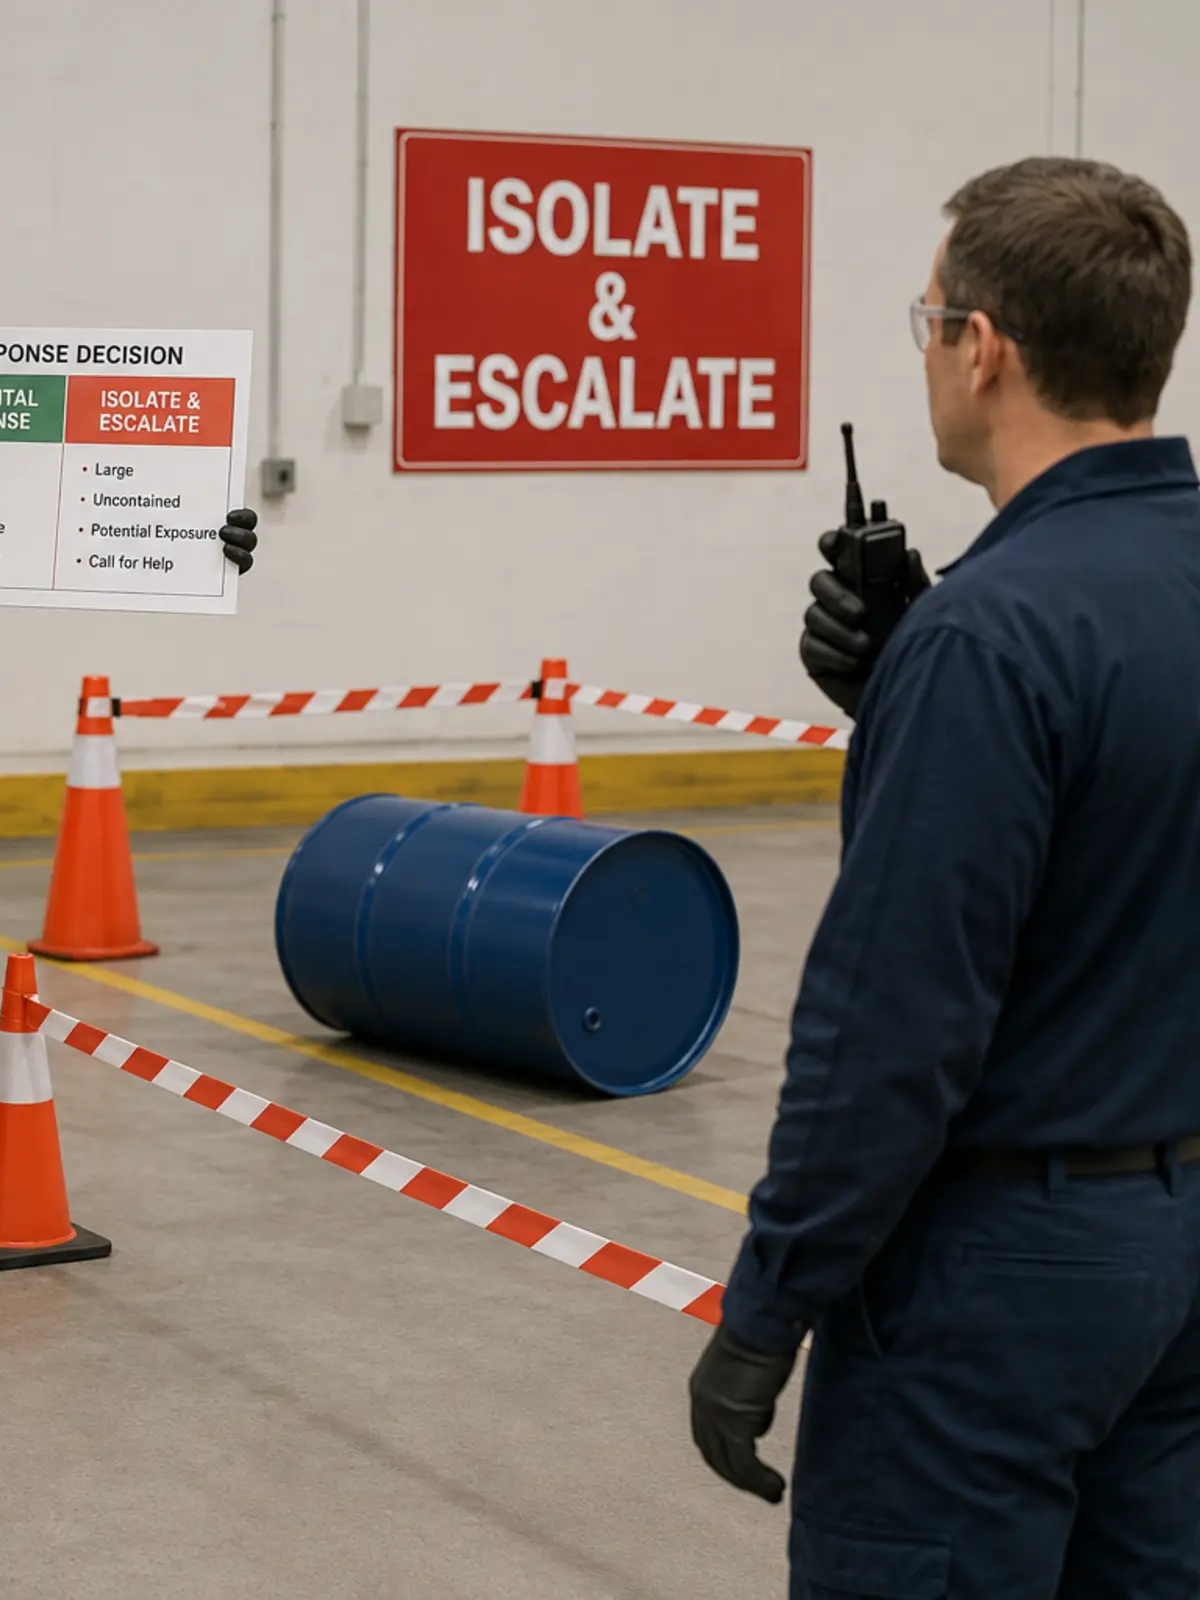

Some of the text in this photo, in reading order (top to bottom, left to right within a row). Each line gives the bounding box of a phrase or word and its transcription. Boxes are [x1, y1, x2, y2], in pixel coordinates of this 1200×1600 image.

[467, 177, 759, 261] ISOLATE
[588, 271, 637, 341] &
[76, 345, 184, 365] DECISION
[101, 391, 201, 410] ISOLATE &
[434, 353, 775, 430] ESCALATE
[99, 415, 200, 434] ESCALATE
[95, 464, 134, 480] Large
[93, 493, 180, 509] Uncontained
[91, 524, 217, 542] Potential Exposure
[89, 555, 174, 573] Call for Help
